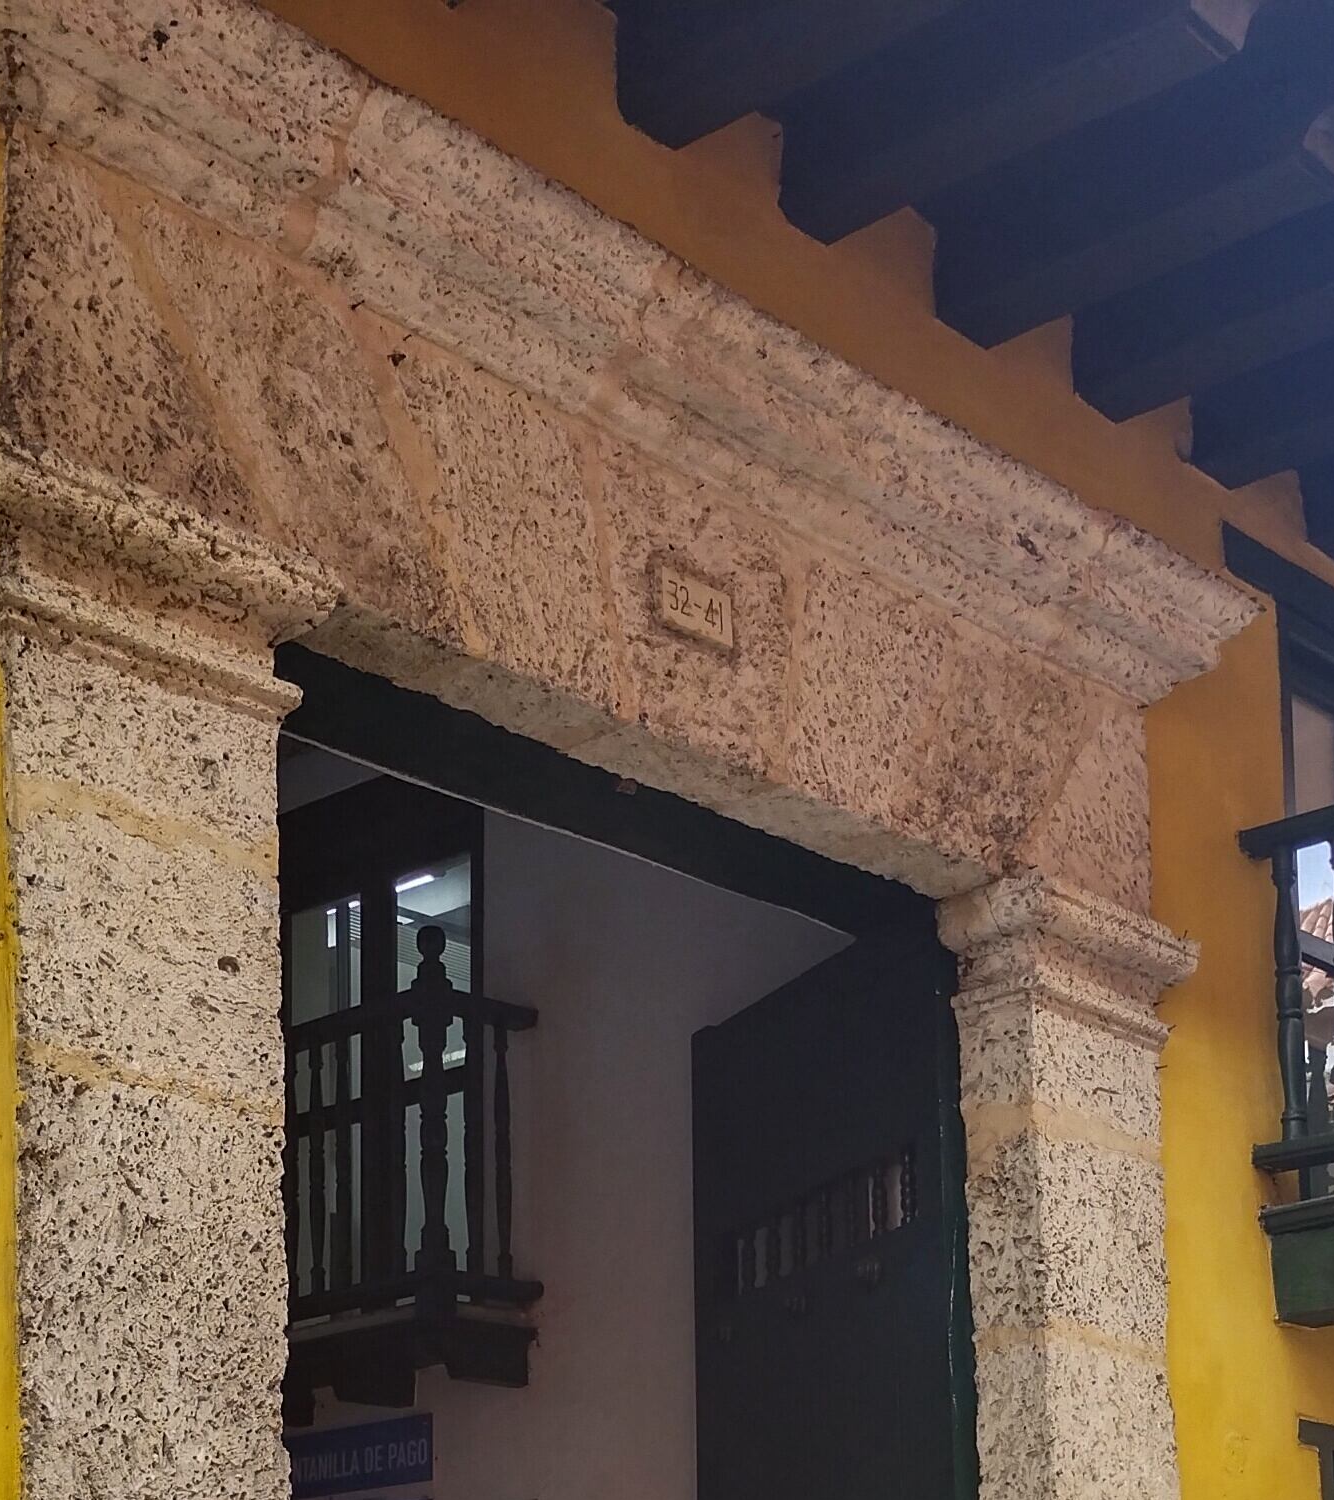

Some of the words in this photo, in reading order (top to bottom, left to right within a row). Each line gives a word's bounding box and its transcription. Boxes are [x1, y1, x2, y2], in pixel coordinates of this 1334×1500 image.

[667, 579, 725, 635] 32-41
[364, 1444, 383, 1474] DE
[388, 1438, 428, 1471] PAGO
